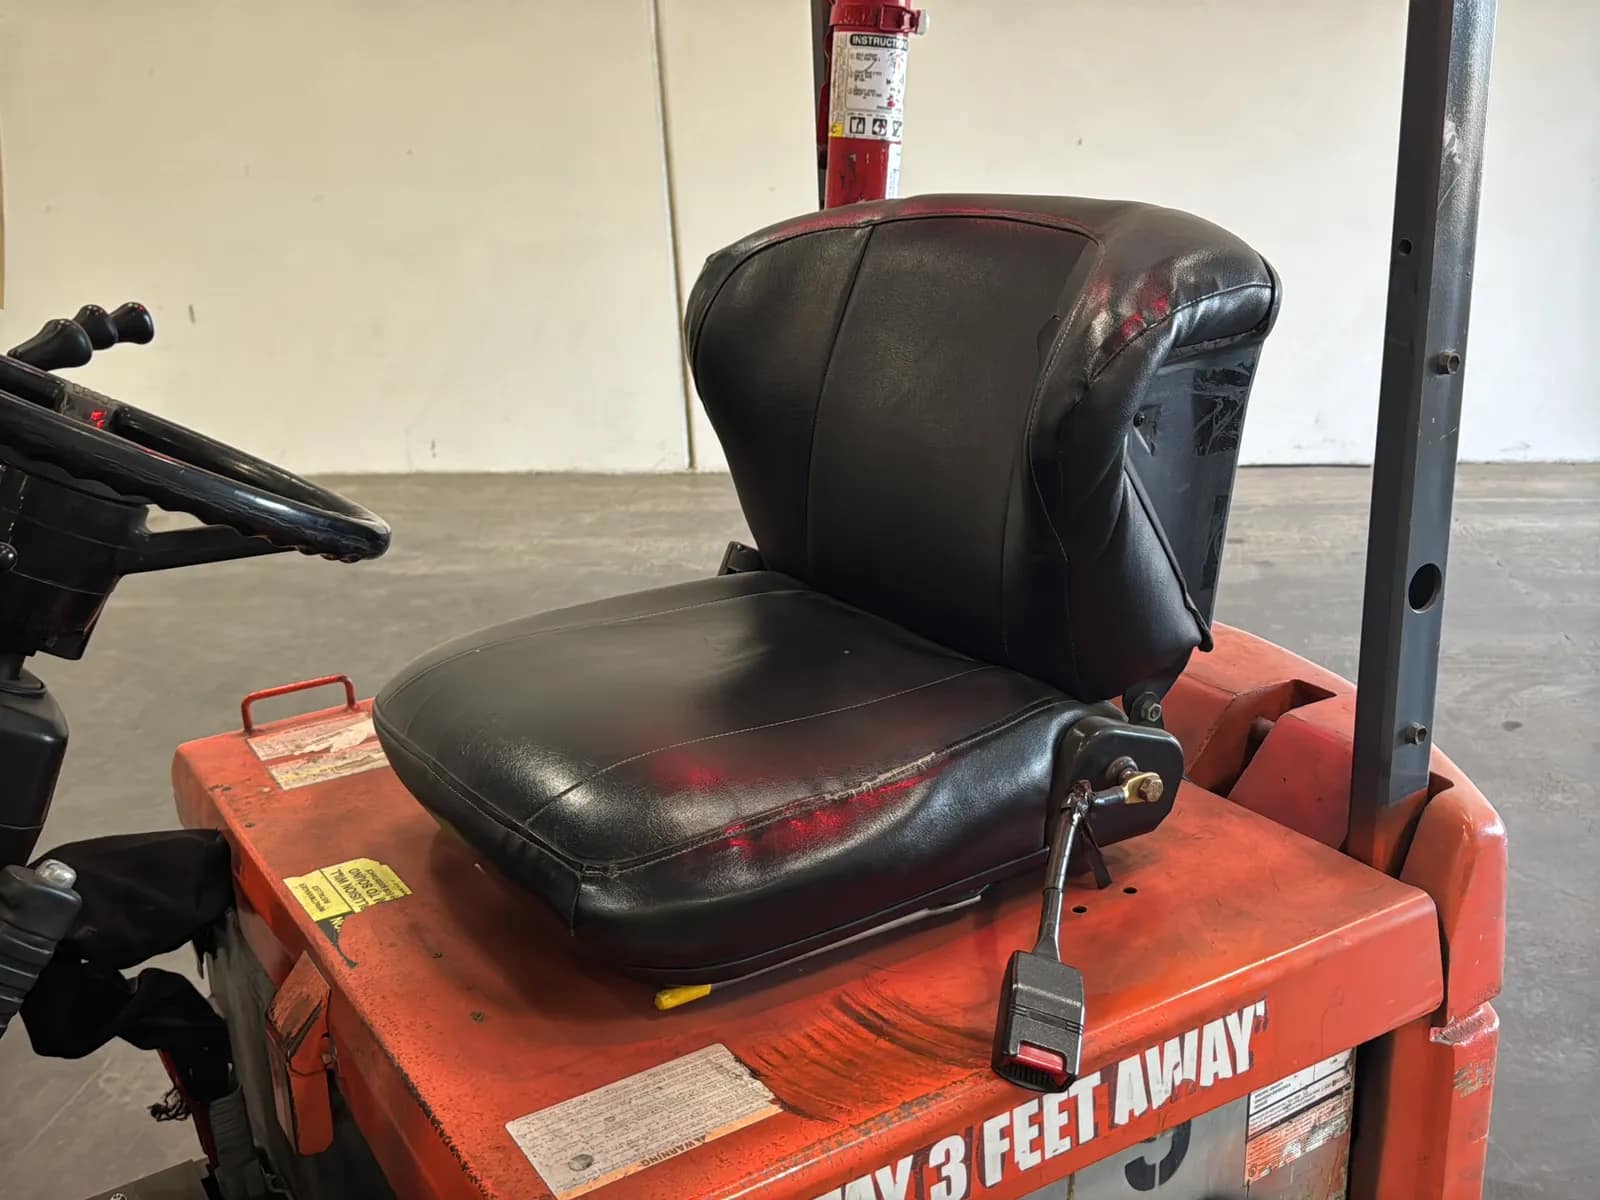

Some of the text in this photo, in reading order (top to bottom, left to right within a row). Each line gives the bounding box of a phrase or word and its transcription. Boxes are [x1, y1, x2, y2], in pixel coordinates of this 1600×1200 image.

[640, 1140, 696, 1167] WARNING
[928, 1134, 968, 1200] 3
[983, 1072, 1101, 1188] FEET
